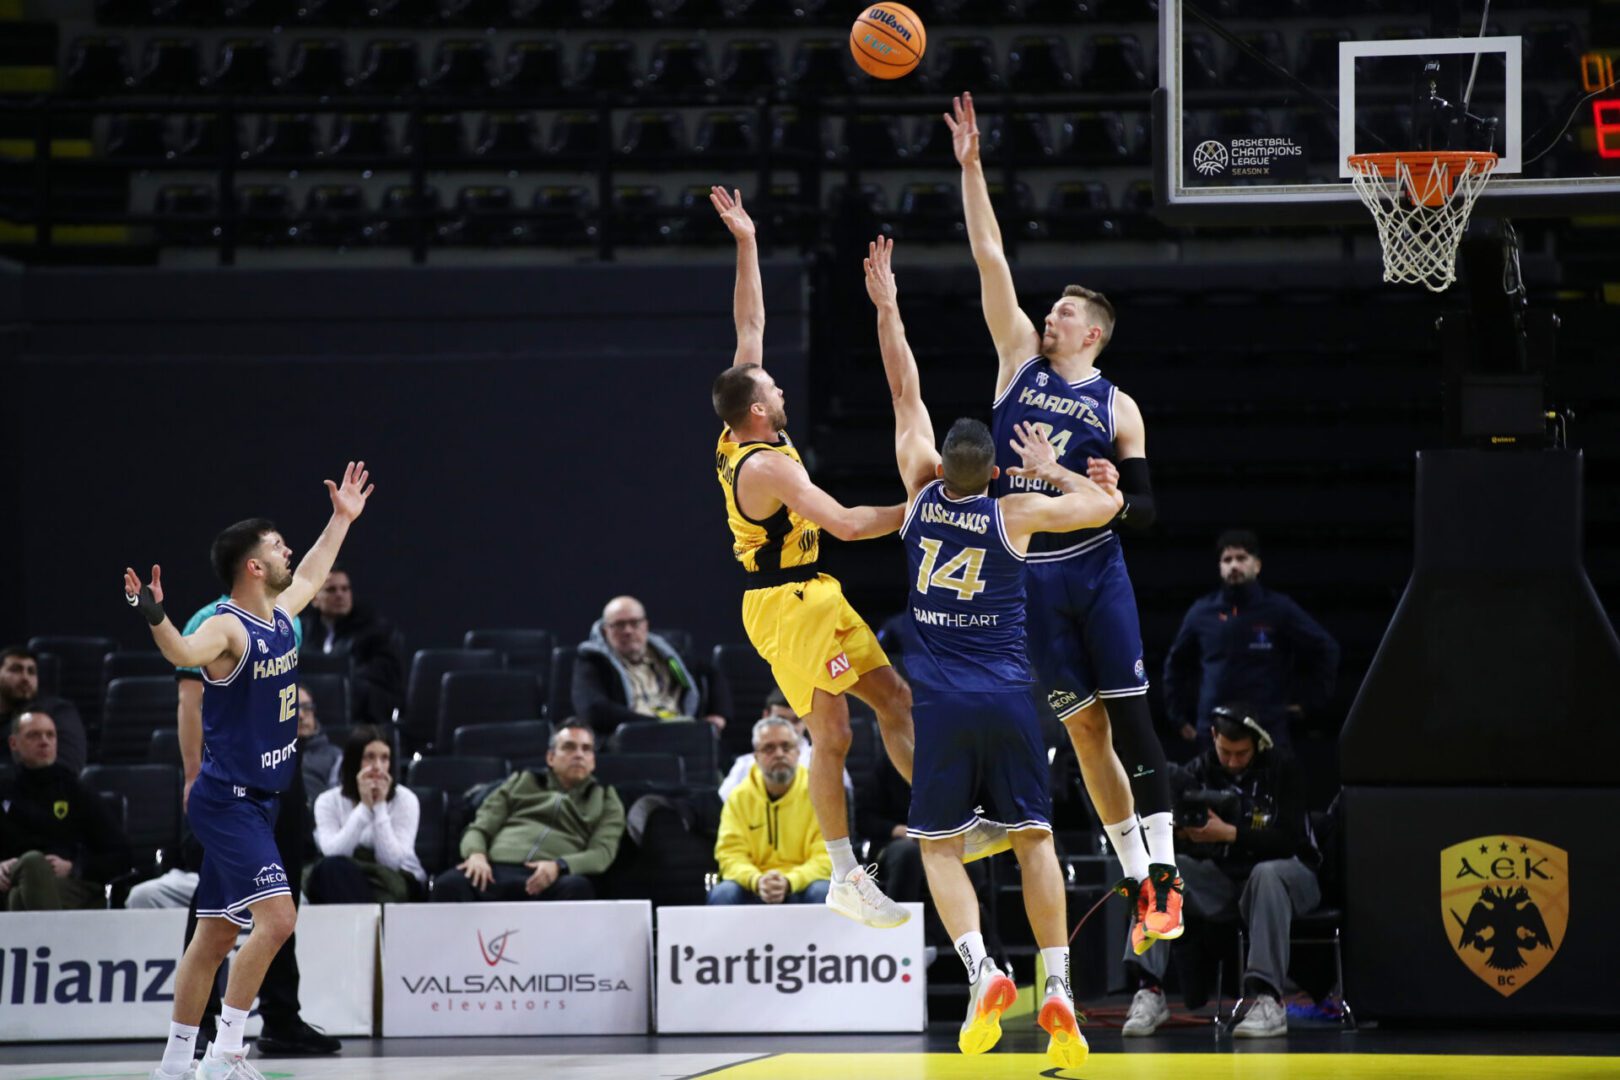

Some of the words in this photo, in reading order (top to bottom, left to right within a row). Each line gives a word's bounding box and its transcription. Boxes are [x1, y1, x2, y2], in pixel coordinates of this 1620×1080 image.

[869, 9, 912, 42] Wilson
[1231, 138, 1294, 147] BASKETBALL
[1231, 146, 1302, 157] CHAMPIONS
[1231, 157, 1269, 166] LEAGUE
[1232, 168, 1262, 176] SEASON
[920, 502, 990, 535] KASELAKIS
[916, 536, 986, 601] 14
[279, 683, 296, 723] 12
[0, 946, 177, 1005] lianz
[1497, 975, 1516, 986] BC
[401, 974, 596, 994] VALSAMIDIS
[431, 998, 566, 1011] elevators
